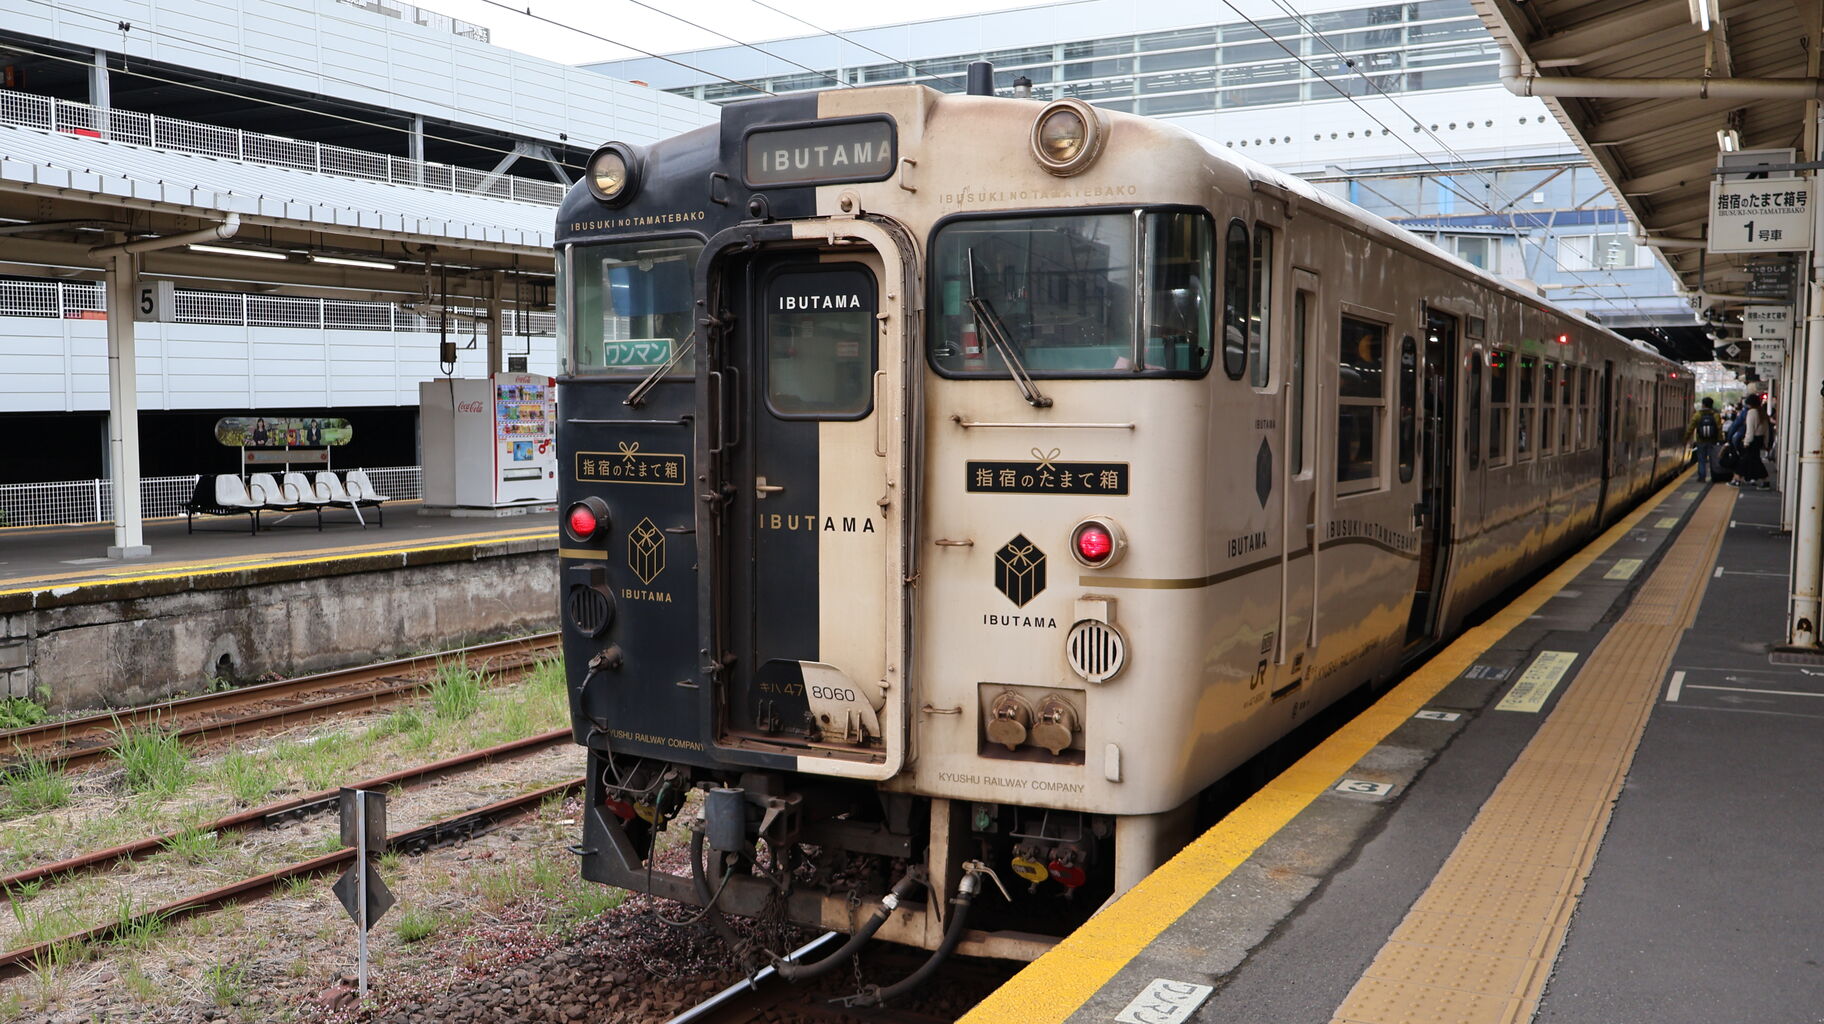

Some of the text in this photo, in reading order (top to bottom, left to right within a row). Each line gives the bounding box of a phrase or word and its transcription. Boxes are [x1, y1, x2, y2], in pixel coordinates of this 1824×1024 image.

[762, 140, 891, 172] IBUTAMA
[939, 191, 1004, 204] IBUSUKI
[1009, 191, 1028, 200] NO
[1718, 191, 1807, 209] 指宿のたまて箱号
[571, 211, 705, 232] IBUSUKI NO TAMATEBAKO
[1744, 221, 1782, 242] 1 号車
[141, 289, 153, 314] 5
[780, 294, 861, 310] IBUTAMA
[606, 342, 667, 364] ワンマン
[583, 459, 678, 479] 指宿のたまて箱
[976, 467, 1119, 489] 指宿のたまて箱
[760, 513, 875, 533] IBUTAMA
[1326, 520, 1361, 539] IBUSUKI
[1228, 531, 1267, 558] IBUTAMA
[621, 589, 672, 603] IBUTAMA
[983, 614, 1057, 629] IBUTAMA
[1250, 659, 1267, 690] JR
[812, 685, 855, 702] 8060
[608, 729, 633, 740] YUSHU
[635, 733, 666, 745] RAILWAY
[939, 772, 1085, 793] KYUSHU RAILWAY COMPANY
